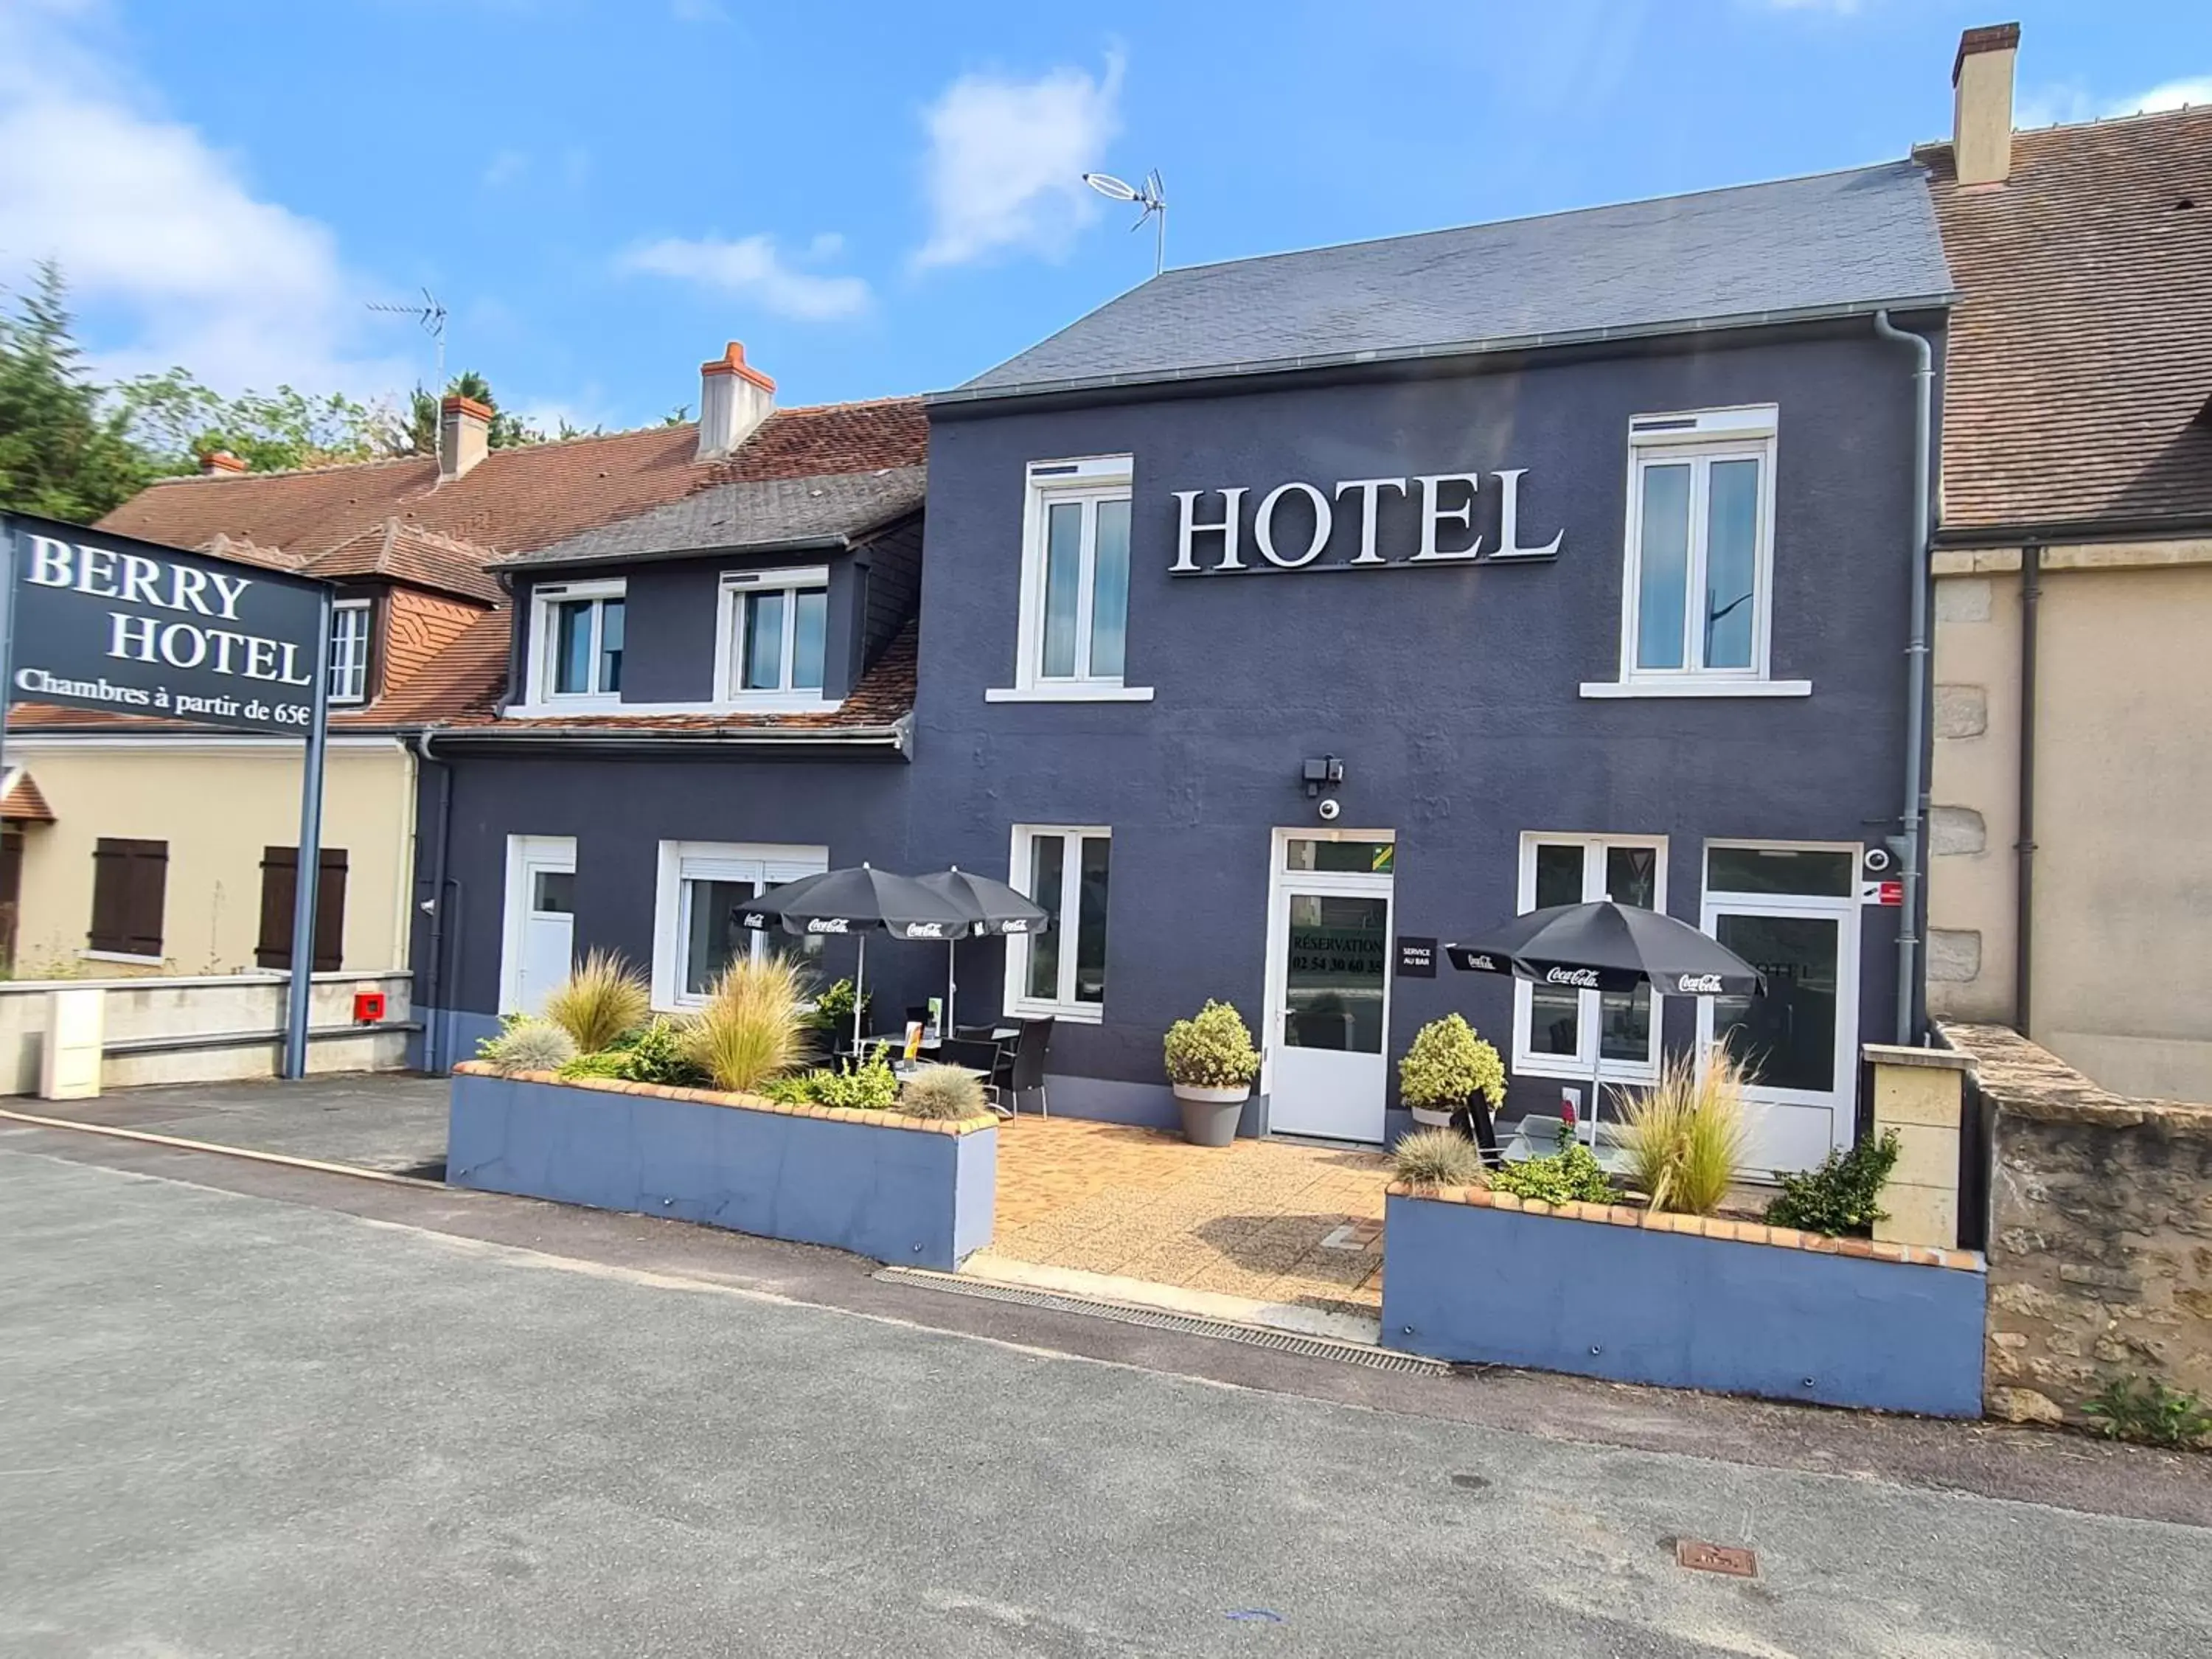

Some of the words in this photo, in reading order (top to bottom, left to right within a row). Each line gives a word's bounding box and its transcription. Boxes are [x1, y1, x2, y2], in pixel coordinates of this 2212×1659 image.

[1168, 468, 1565, 572] HOTEL
[24, 534, 253, 620] BERRY
[106, 612, 313, 686] HOTEL
[15, 668, 149, 705] Chambres
[153, 686, 170, 708] à
[175, 695, 240, 715] partir
[244, 700, 270, 720] de
[274, 703, 310, 725] 65€
[1403, 947, 1430, 956] SERVICE
